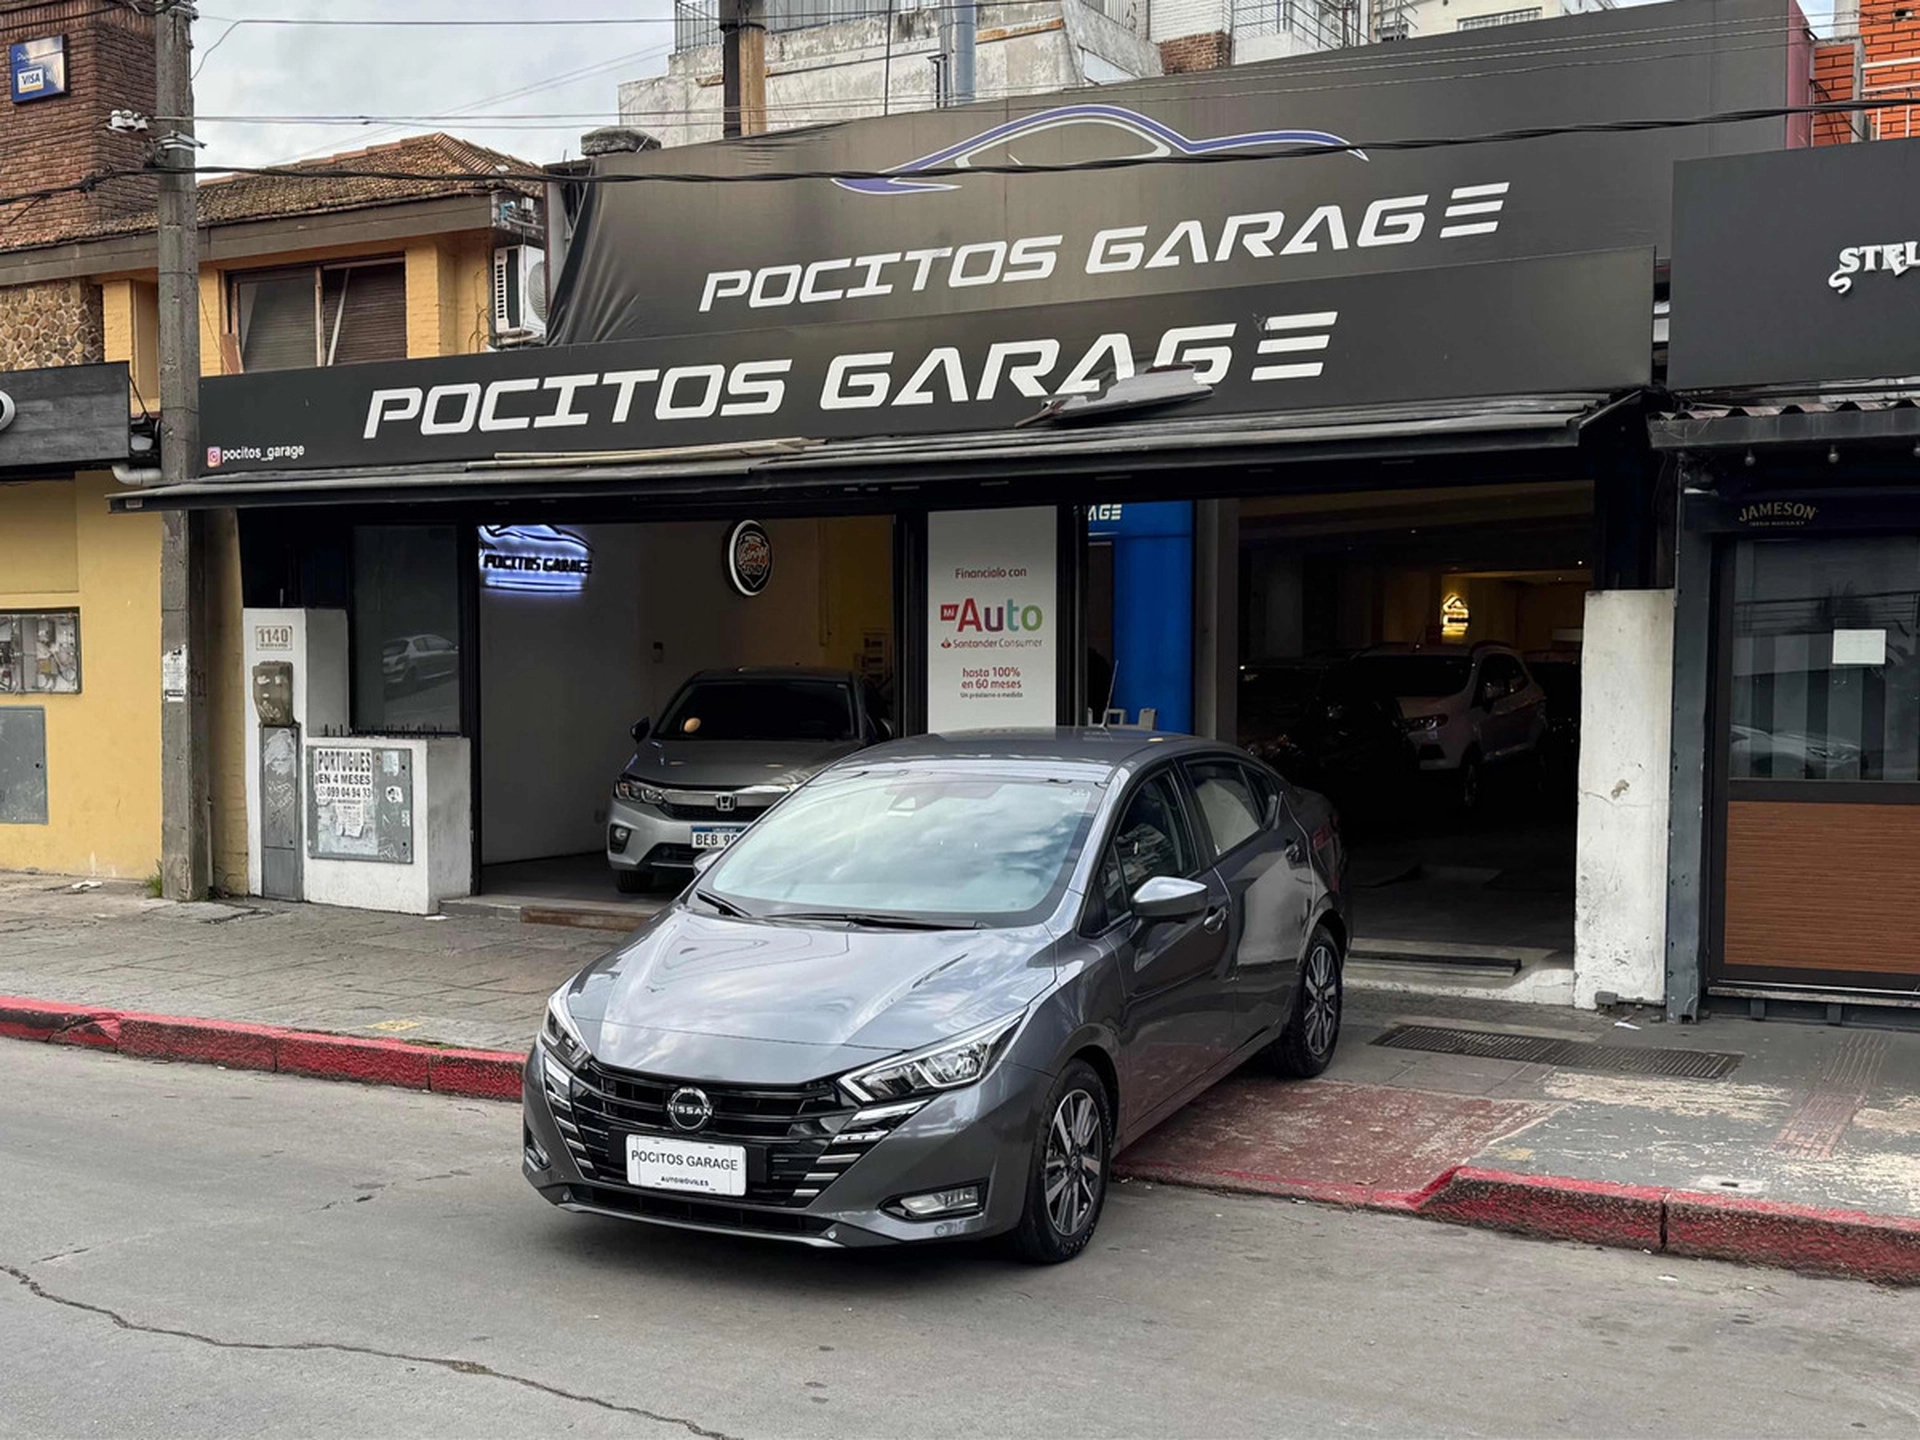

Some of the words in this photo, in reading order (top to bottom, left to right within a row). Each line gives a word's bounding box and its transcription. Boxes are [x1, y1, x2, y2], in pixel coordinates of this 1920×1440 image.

[21, 72, 41, 85] VISA
[699, 234, 1063, 313] POCITOS
[1085, 181, 1510, 275] GARAGE
[363, 359, 793, 439] POCITOS
[819, 311, 1338, 410] GARAGE
[222, 445, 305, 463] pocitos_garage
[1739, 502, 1816, 522] JAMESON
[1008, 567, 1027, 578] con
[957, 598, 1043, 632] Auto
[258, 628, 289, 643] 1140
[953, 639, 998, 649] Santander
[999, 638, 1042, 648] Consumer
[962, 667, 990, 678] hasta
[992, 667, 1021, 677] 100%
[961, 680, 974, 689] en
[975, 678, 989, 689] 60
[990, 679, 1022, 689] meses
[319, 774, 331, 784] EN
[332, 774, 339, 784] 4
[341, 774, 371, 785] MESES
[667, 1103, 713, 1117] NISSAN
[631, 1150, 684, 1166] POCITOS
[686, 1155, 738, 1171] GARAGE
